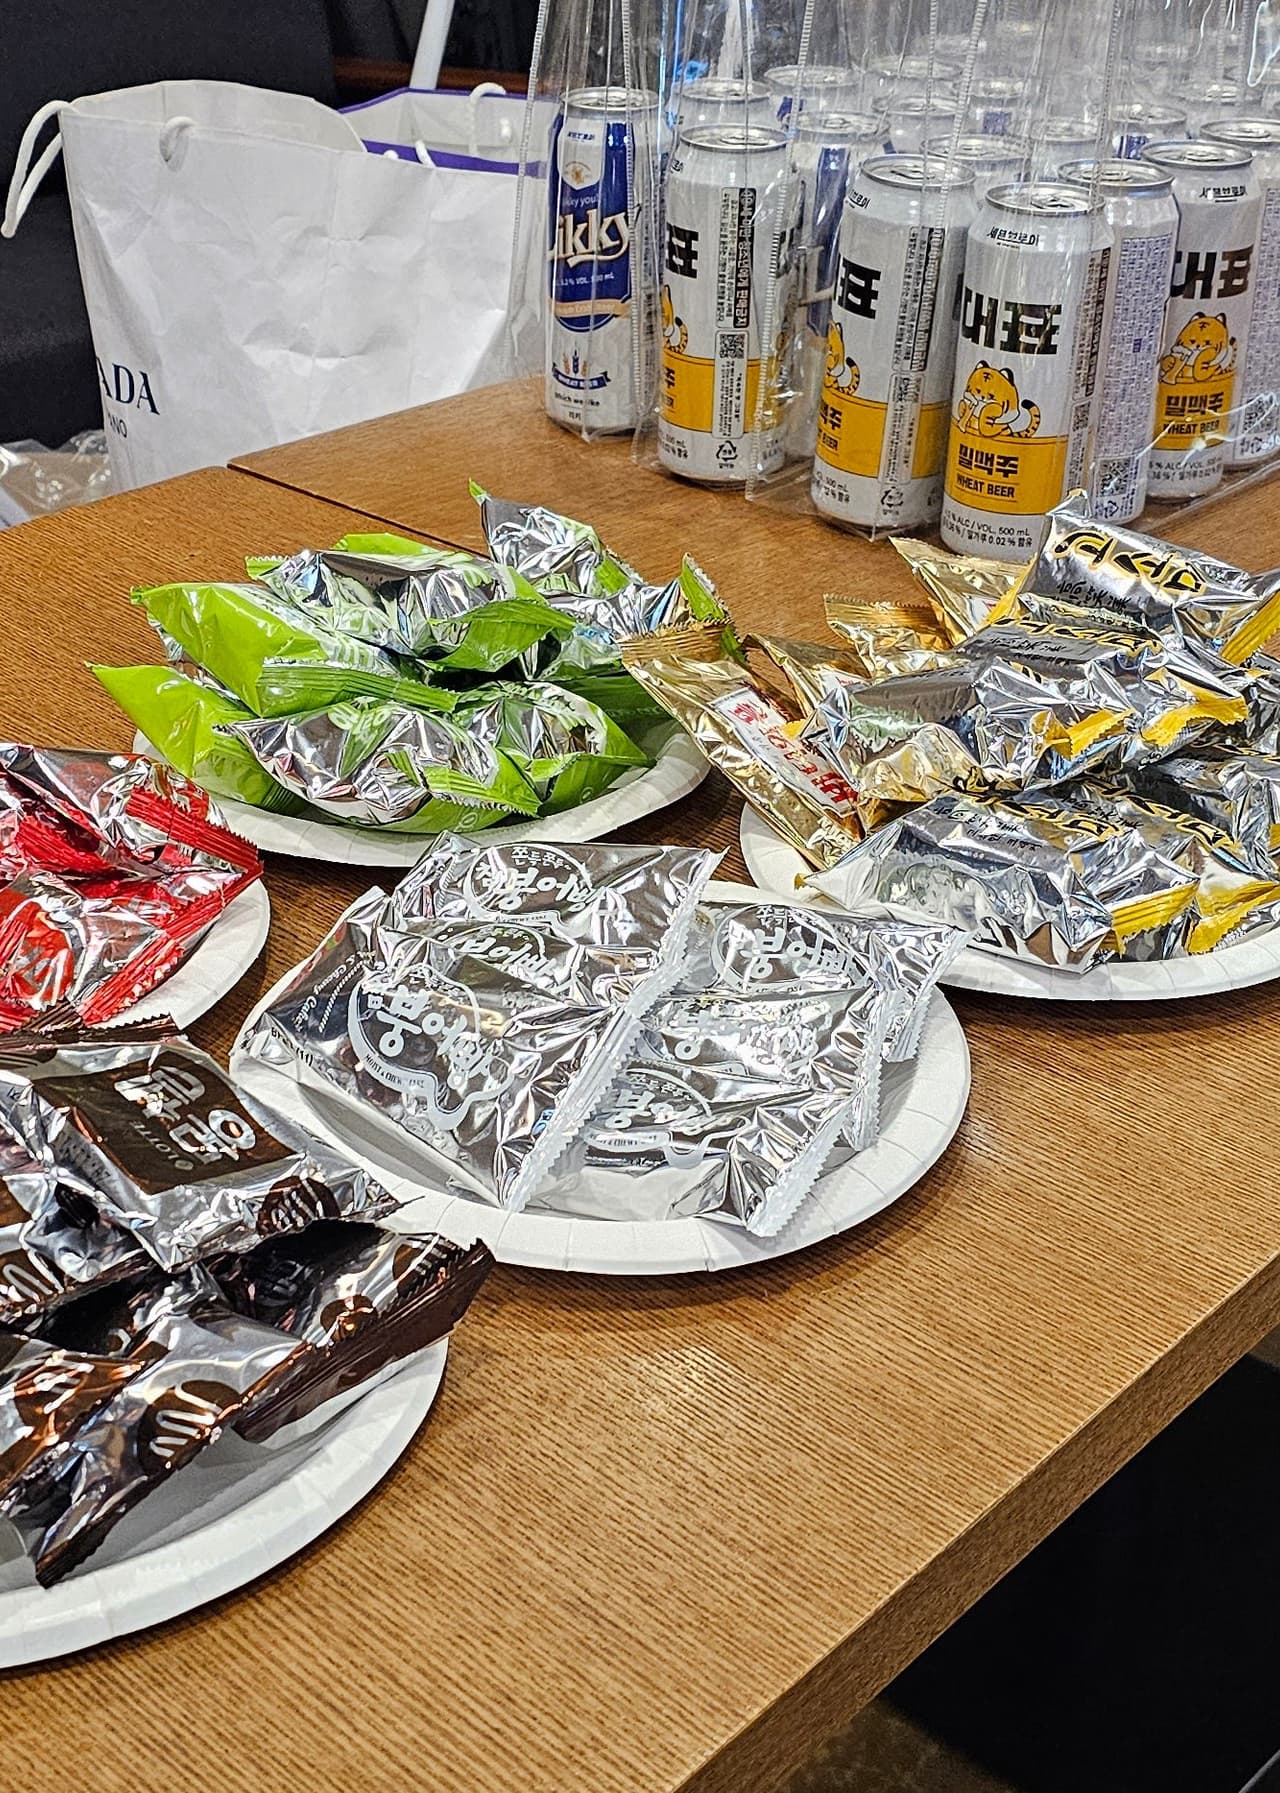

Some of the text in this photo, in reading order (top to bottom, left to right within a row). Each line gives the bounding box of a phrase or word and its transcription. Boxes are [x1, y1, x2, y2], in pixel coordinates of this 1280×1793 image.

[1170, 244, 1254, 299] 대표
[735, 289, 749, 328] 판매금지
[962, 286, 1062, 355] 대표
[1165, 392, 1224, 417] 밀맥주
[1163, 420, 1220, 435] WHEAT BEER
[958, 443, 1019, 479] 밀맥주
[956, 473, 1016, 499] WHEAT BEER
[998, 526, 1015, 537] 500
[1016, 527, 1031, 537] mL
[113, 1065, 257, 1166] 몽쉘
[129, 1120, 180, 1161] LOTTE
